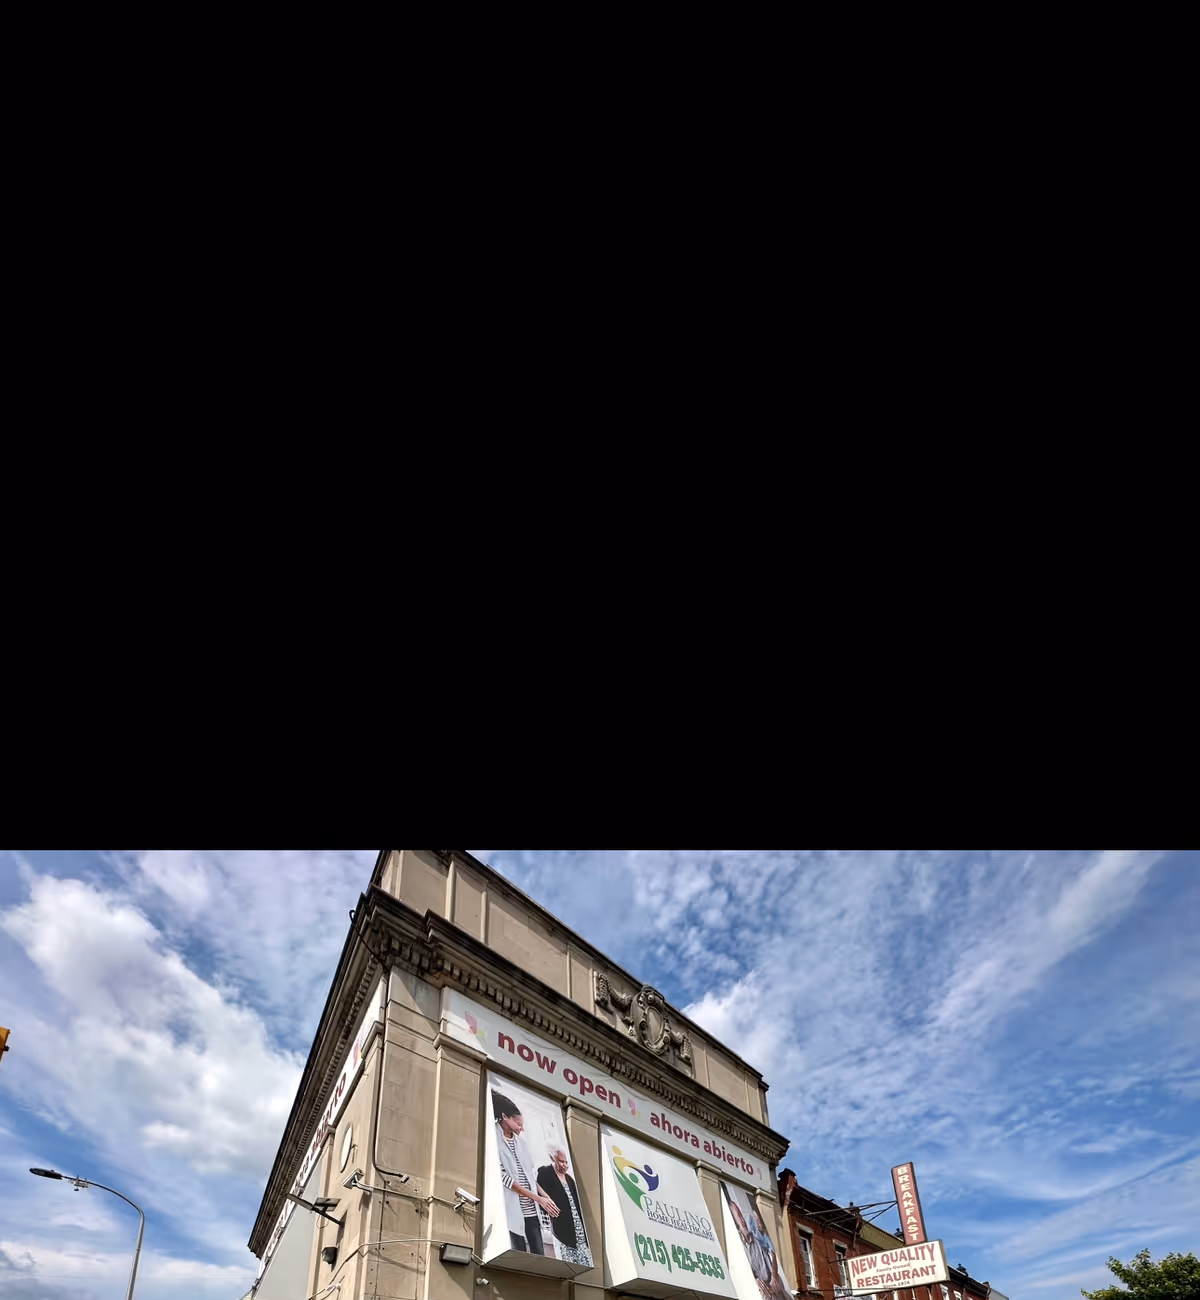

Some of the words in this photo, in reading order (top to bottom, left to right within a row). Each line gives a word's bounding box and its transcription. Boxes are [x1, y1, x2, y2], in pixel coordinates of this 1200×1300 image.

[498, 1031, 557, 1074] now
[563, 1068, 622, 1108] open
[649, 1112, 700, 1149] ahora
[703, 1140, 754, 1176] abierto
[643, 1195, 712, 1231] PAULINO
[647, 1209, 669, 1224] HOME
[897, 1166, 919, 1241] BREAKFAST
[633, 1231, 672, 1273] (215)
[671, 1244, 725, 1280] 425-5535
[851, 1255, 877, 1277] NEW
[880, 1243, 935, 1265] QUALITY
[856, 1265, 936, 1288] RESTAURANT
